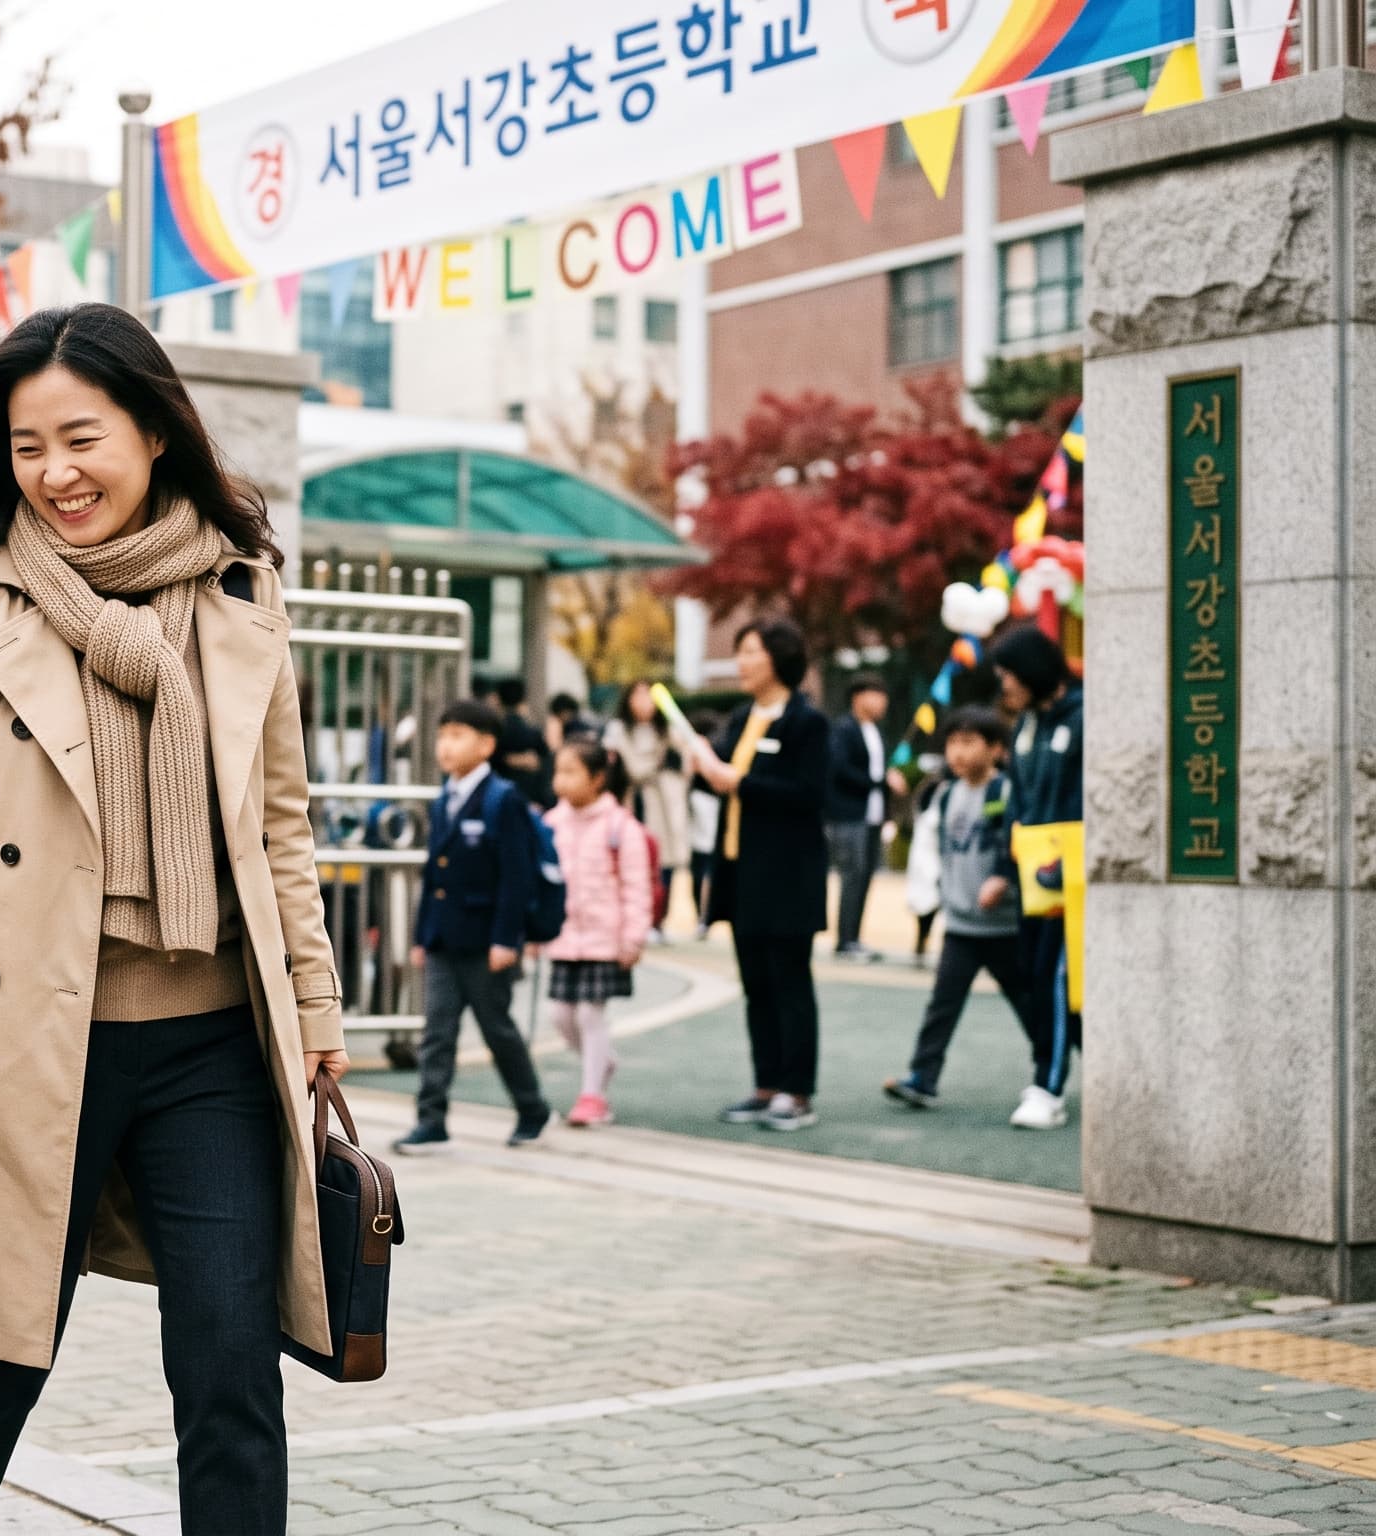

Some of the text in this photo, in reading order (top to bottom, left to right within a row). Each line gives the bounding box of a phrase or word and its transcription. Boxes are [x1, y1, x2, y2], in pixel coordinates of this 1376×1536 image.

[248, 0, 818, 224] 경 서울서강초등학교
[382, 153, 787, 310] WELCOME
[1183, 394, 1226, 859] 서울서강초등학교
